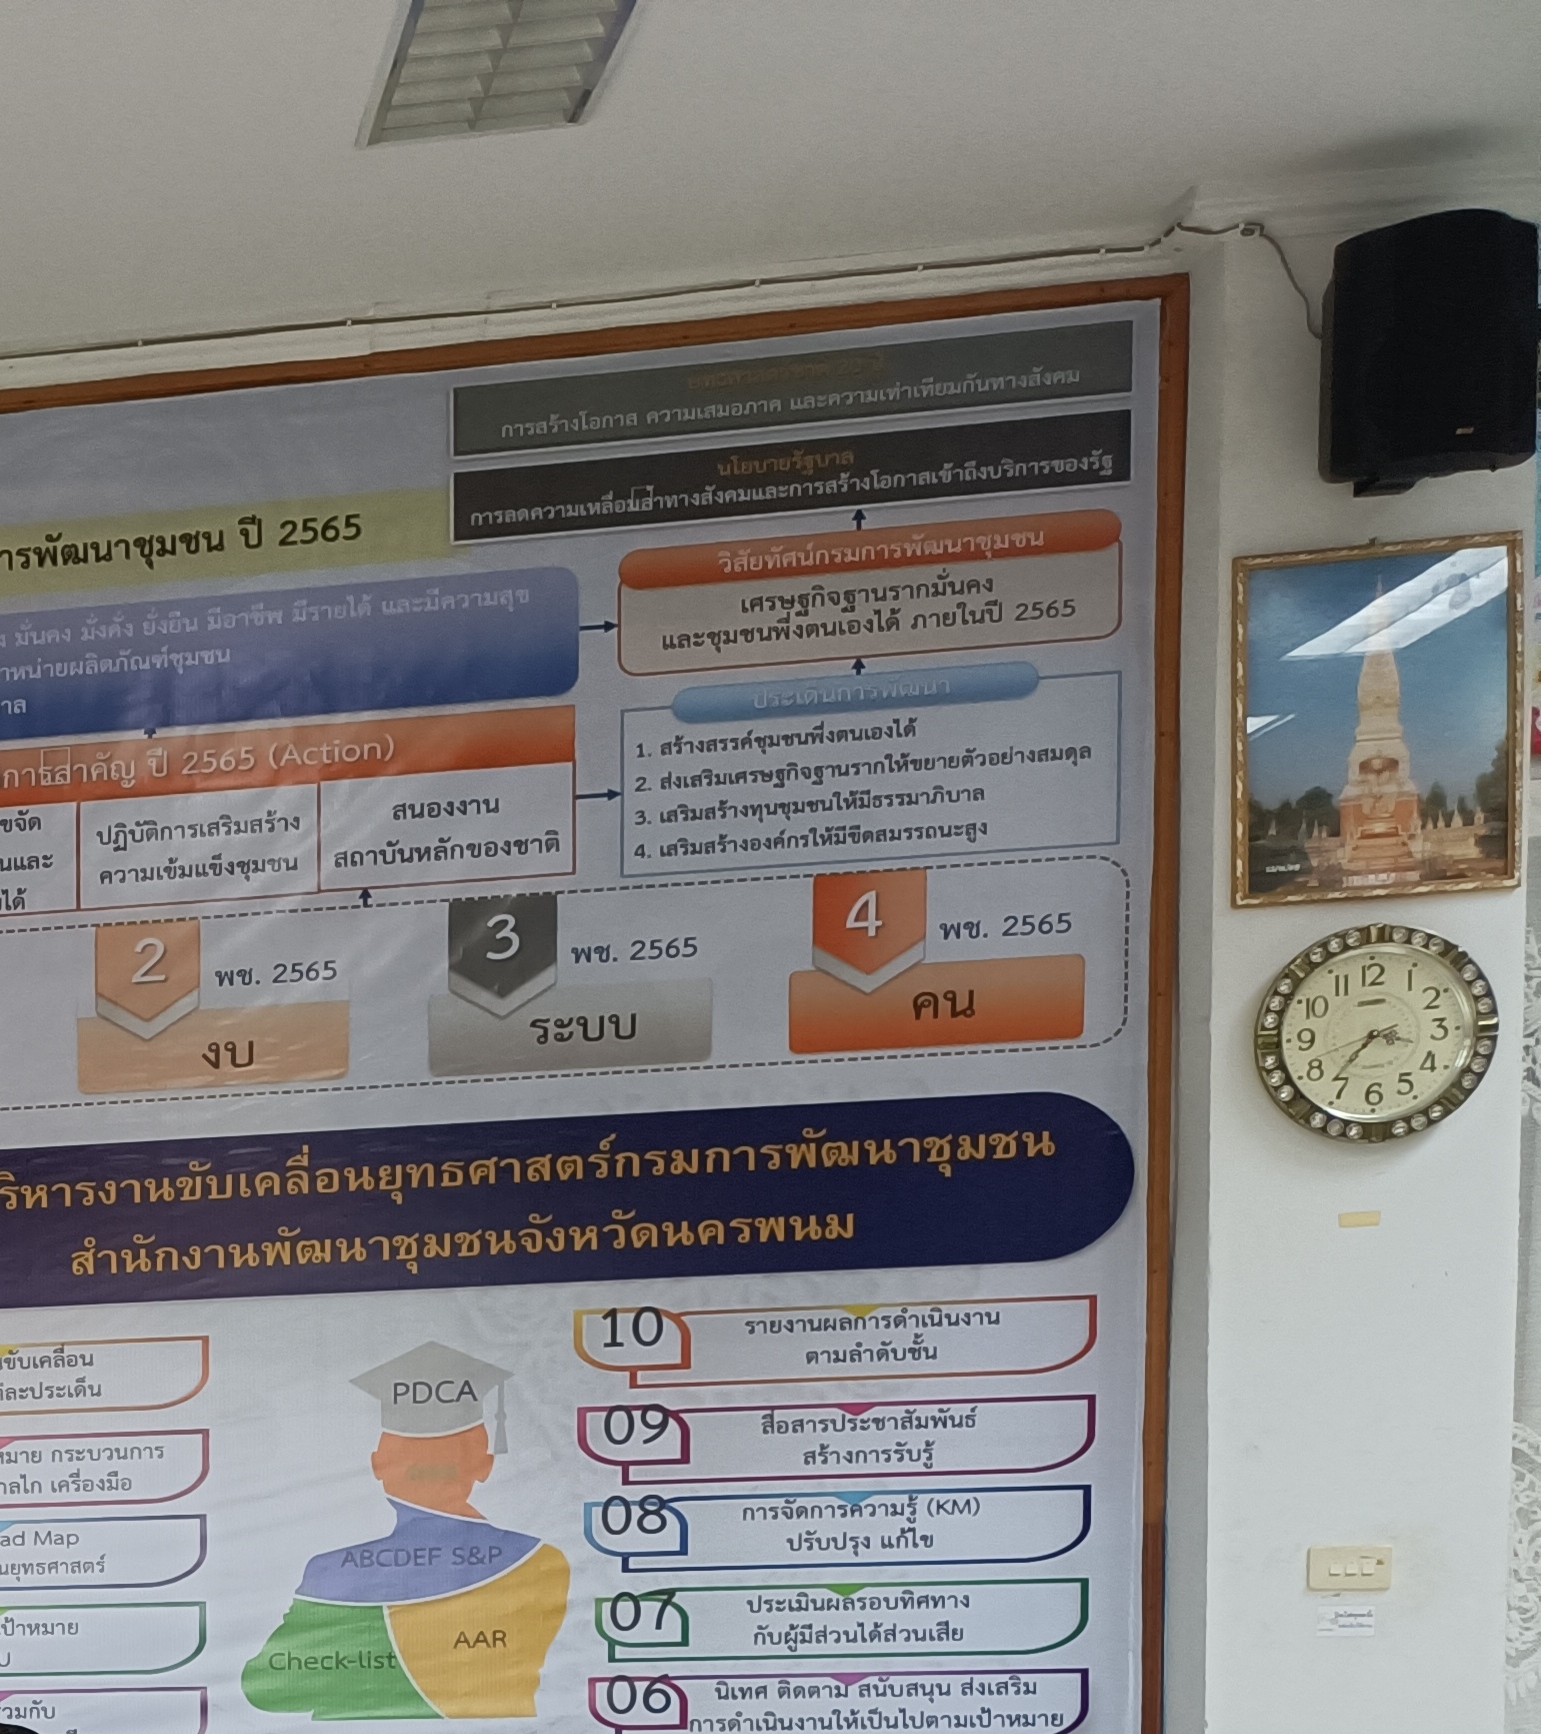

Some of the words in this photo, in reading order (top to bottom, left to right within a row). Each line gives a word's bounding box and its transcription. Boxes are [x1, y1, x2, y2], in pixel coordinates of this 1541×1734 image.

[500, 407, 638, 440] การสร้างโอกาส
[239, 514, 263, 550] ปี
[279, 514, 363, 546] 2565
[718, 525, 1045, 576] วิสัยทัศน์กรมการพัฒนาชุมชน
[143, 613, 199, 638] ยั่งยืน
[381, 587, 529, 616] และมีความสุข
[739, 575, 994, 617] เศรษฐกิจฐานรากมั่นคง
[662, 606, 901, 655] และชุมชนพึ่งตนเองได้
[911, 597, 1003, 629] ภายในปี
[1014, 598, 1076, 622] 2565
[753, 677, 950, 710] ประเด็นการพัฒนา
[660, 717, 917, 757] สร้างสรรค์ชุมชนพึ่งตนเองได้
[148, 750, 168, 778] ปี
[182, 746, 255, 775] 2565
[269, 734, 395, 770] (Action)
[660, 743, 1091, 791] ส่งเสริมเศรษฐกิจฐานรากให้ขยายตัวอย่างสมดุล
[391, 795, 500, 822] สนองงาน
[660, 784, 985, 825] เสริมสร้างทุนชุมชนให้มีธรรมาภิบาล
[96, 810, 301, 853] ปฏิบัติการเสริมสร้าง
[660, 820, 988, 859] เสริมสร้างองค์กรให้มีขีดสมรรถนะสูง
[333, 830, 560, 869] สถาบันหลักของชาติ
[99, 853, 298, 886] ความเข้มแข็งชุมชน
[845, 890, 883, 938] 4
[1002, 912, 1073, 937] 2565
[485, 914, 520, 961] 3
[630, 936, 698, 961] 2565
[131, 937, 167, 983] 2
[272, 959, 337, 985] 2565
[1360, 963, 1387, 987] 12
[1334, 974, 1351, 996] 11
[912, 987, 975, 1021] คน
[529, 1011, 637, 1045] ระบบ
[202, 1039, 255, 1070] งบ
[1365, 1083, 1384, 1106] 6
[1396, 1071, 1414, 1096] 5
[71, 1208, 855, 1276] สำนักงานพัฒนาชุมชนจังหวัดนครพนม
[601, 1307, 664, 1348] 10
[745, 1308, 1000, 1335] รายงานผลการดำเนินงาน
[806, 1334, 938, 1366] ตามลำดับชั้น
[393, 1380, 478, 1404] PDCA
[603, 1404, 670, 1446] 09
[761, 1407, 977, 1437] สื่อสารประชาสัมพันธ์
[51, 1443, 165, 1464] กระบวนการ
[803, 1440, 935, 1470] สร้างการรับรู้
[51, 1469, 132, 1495] เครื่องมือ
[601, 1495, 669, 1536] 08
[742, 1496, 918, 1526] การจัดการความรู้
[927, 1497, 981, 1518] (KM)
[34, 1530, 79, 1549] Map
[786, 1531, 872, 1558] ปรับปรุง
[880, 1528, 934, 1551] แก้ไข
[341, 1548, 441, 1569] ABCDEF
[451, 1546, 502, 1566] S&P
[610, 1591, 676, 1631] 07
[746, 1591, 969, 1616] ประเมินผลรอบทิศทาง
[453, 1630, 507, 1649] AAR
[753, 1621, 964, 1653] กับผู้มีส่วนได้ส่วนเสีย
[268, 1651, 396, 1672] Check-list
[606, 1675, 672, 1715] 06
[715, 1680, 768, 1703] นิเทศ
[778, 1677, 849, 1700] ติดตาม
[857, 1676, 952, 1704] สนับสนุน
[960, 1674, 1037, 1699] ส่งเสริม
[690, 1706, 1064, 1734] การดำเนินงานให้เป็นไปตามเป้าหมาย
